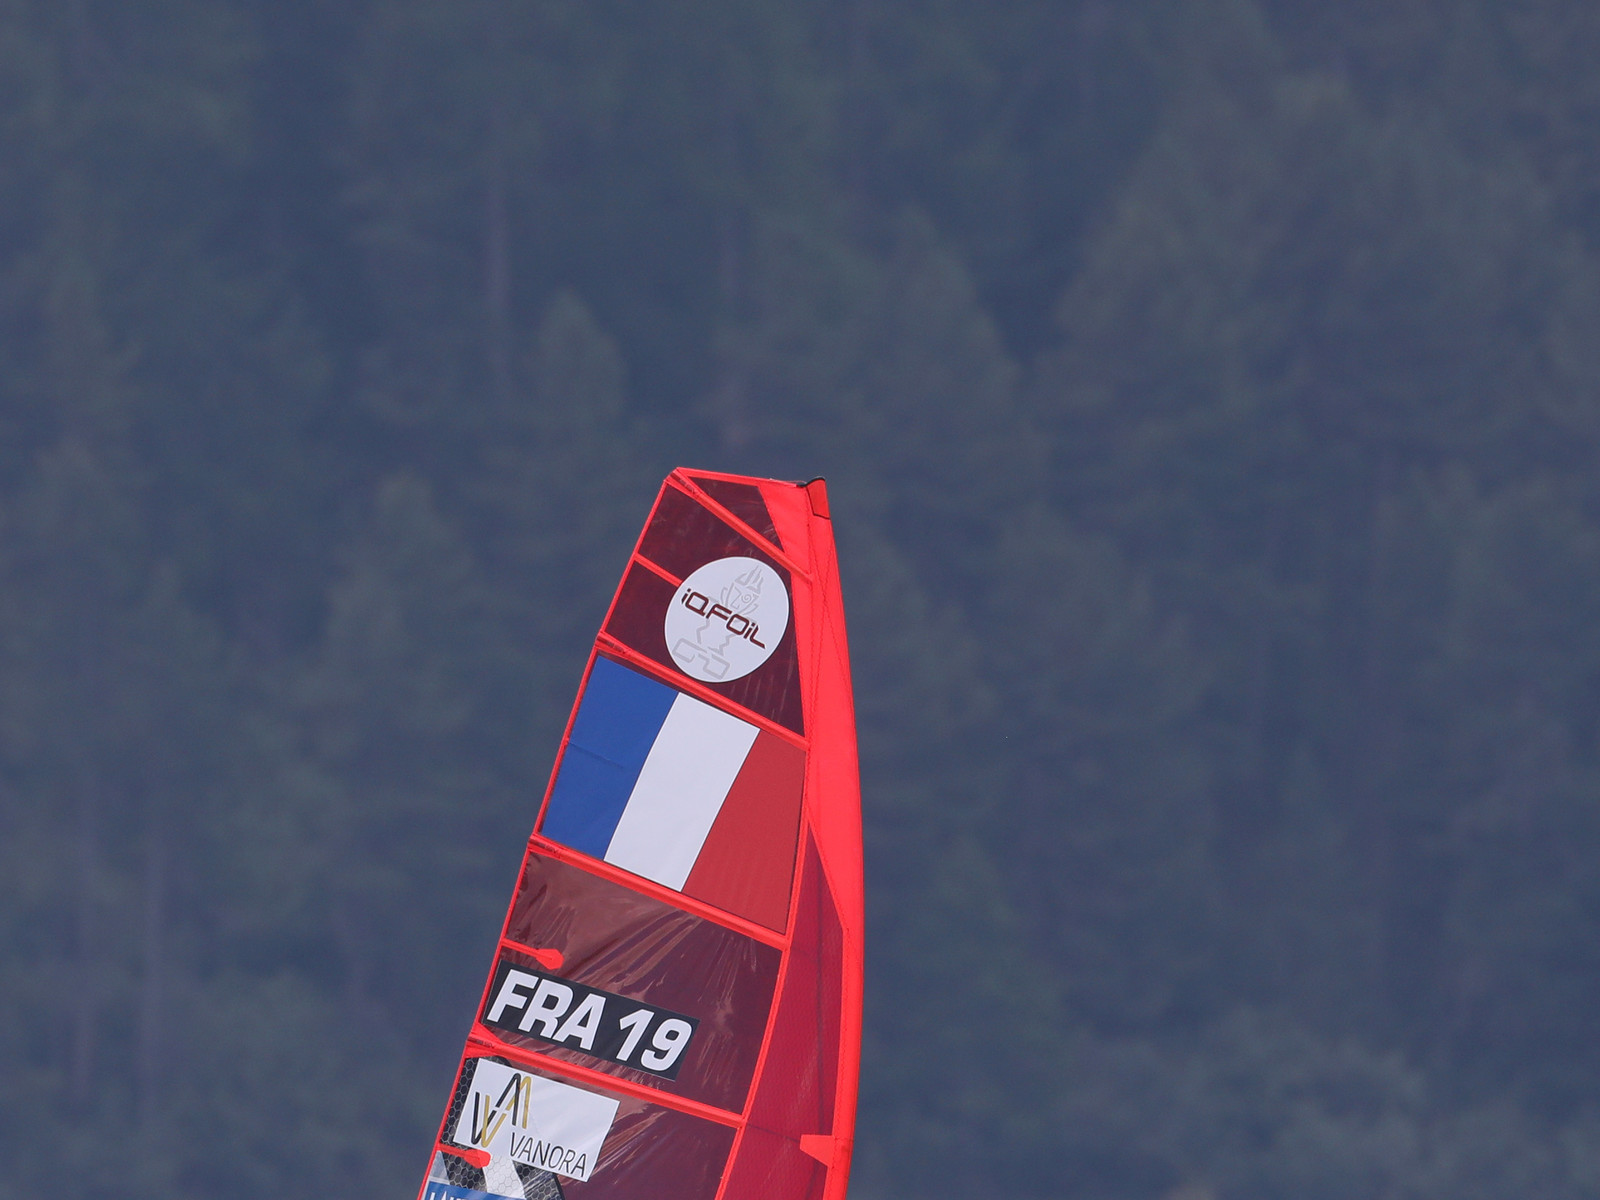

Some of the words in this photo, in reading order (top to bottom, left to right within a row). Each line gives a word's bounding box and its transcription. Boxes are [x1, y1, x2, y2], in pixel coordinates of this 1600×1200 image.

[486, 968, 607, 1051] FRA
[615, 1009, 693, 1072] 19
[510, 1132, 589, 1178] VANORA
